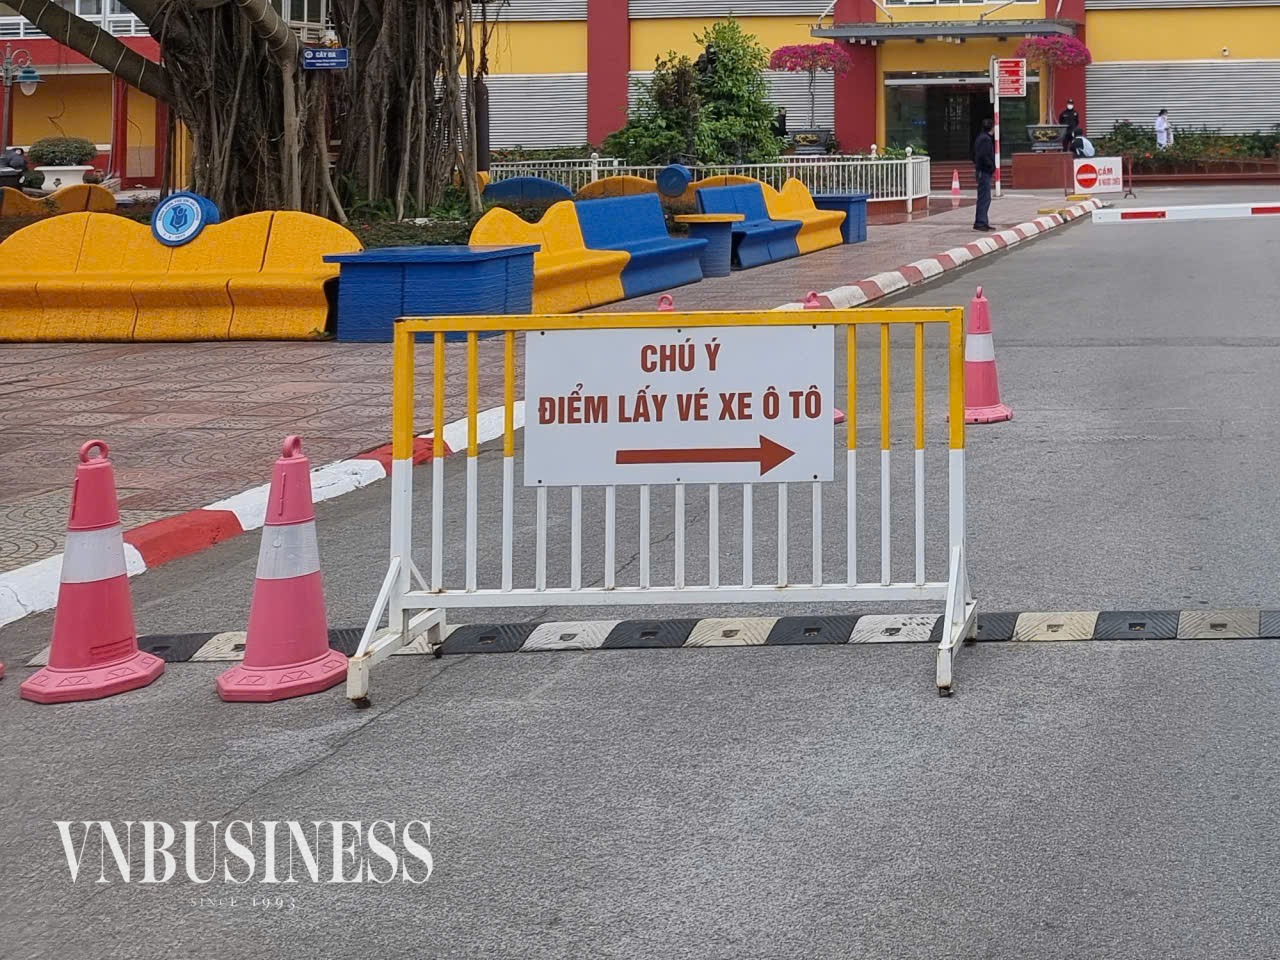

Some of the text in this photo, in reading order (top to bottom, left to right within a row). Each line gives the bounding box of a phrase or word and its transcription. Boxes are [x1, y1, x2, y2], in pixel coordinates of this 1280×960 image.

[640, 337, 721, 373] CHÚ Ý
[538, 383, 822, 425] ĐIỂM LẤY VÉ XE Ô TÔ
